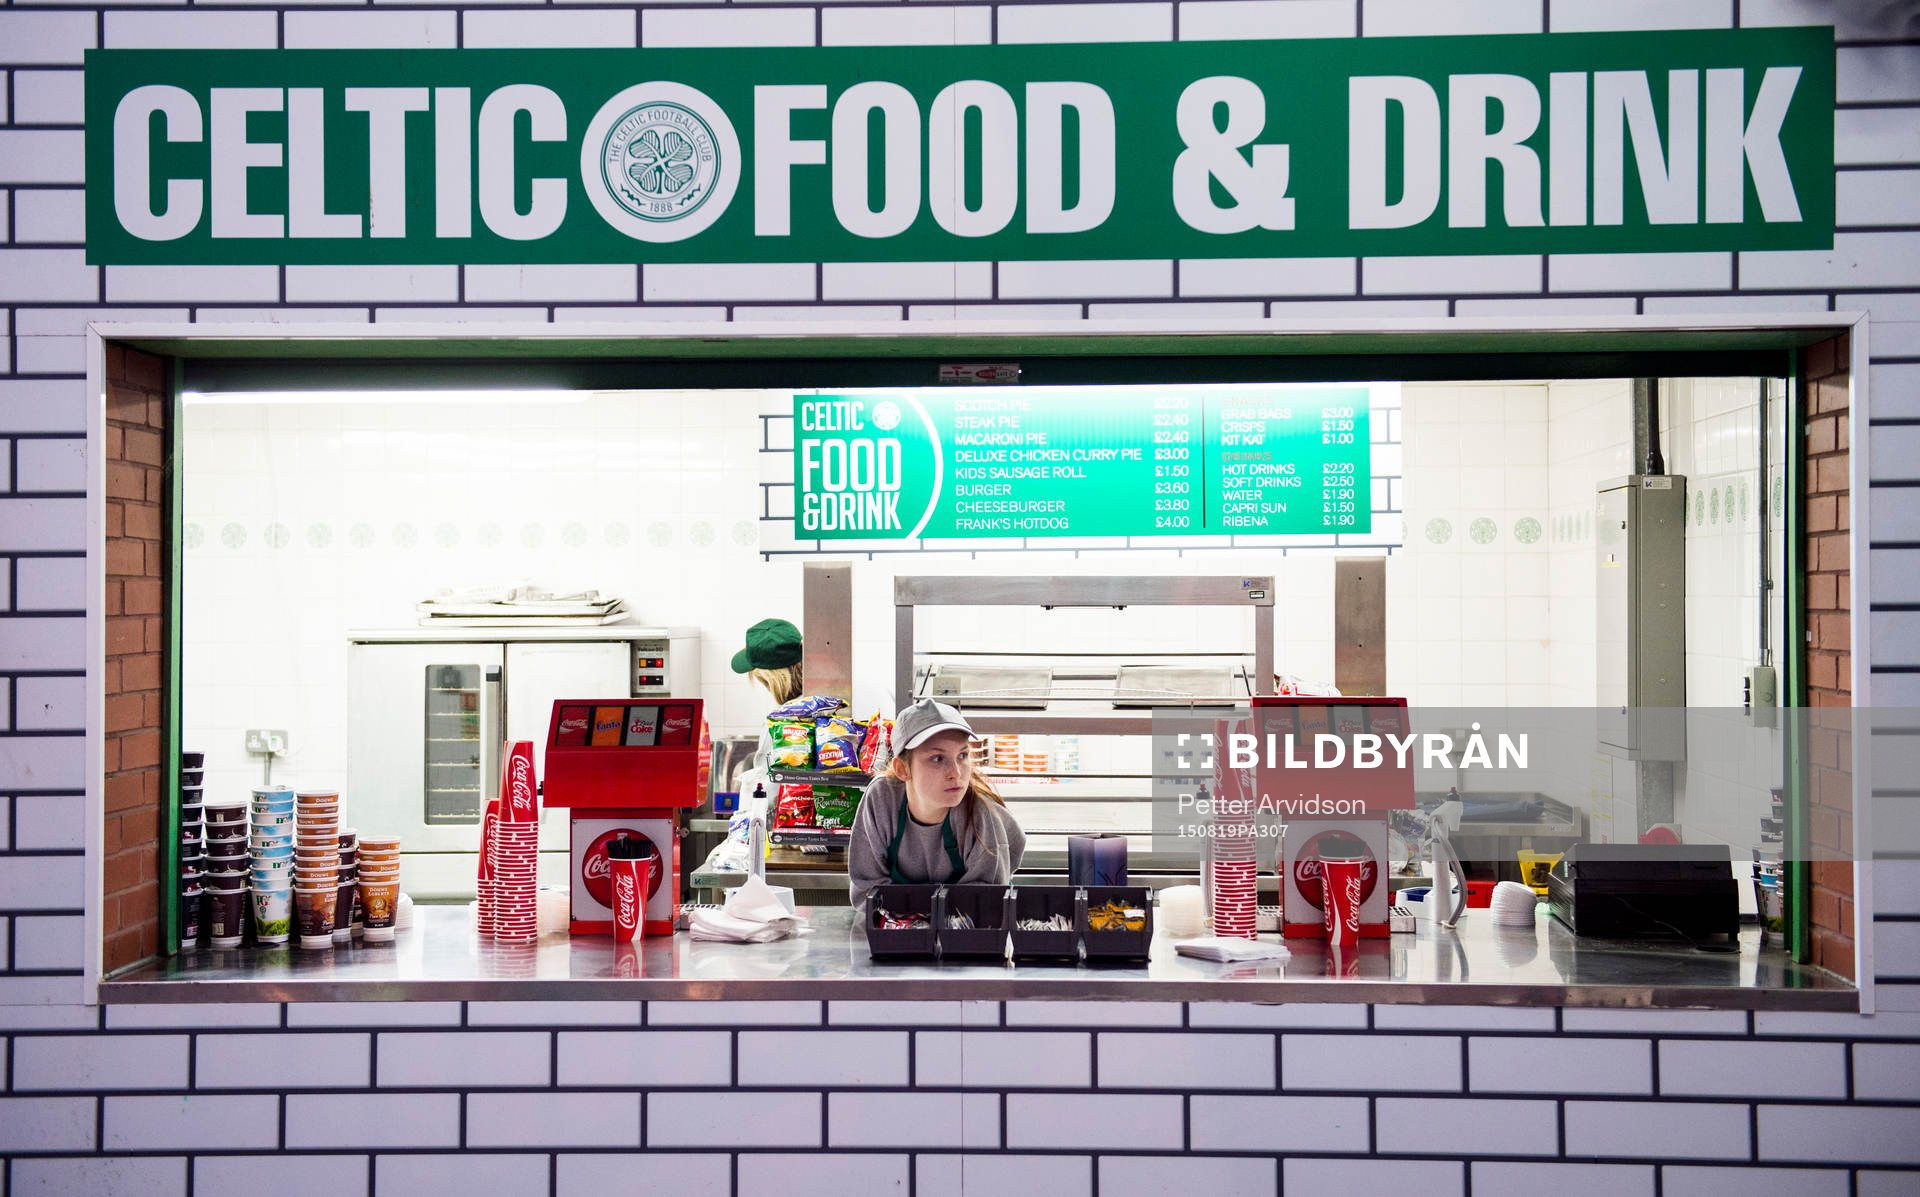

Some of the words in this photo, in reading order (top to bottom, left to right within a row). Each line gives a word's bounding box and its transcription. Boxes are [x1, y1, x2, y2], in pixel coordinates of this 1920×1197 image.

[609, 143, 621, 163] THE
[617, 114, 646, 141] CELTIC
[648, 110, 699, 135] FOOTBALL
[696, 134, 712, 162] CLUB
[114, 84, 567, 241] CELTIC
[754, 80, 1116, 238] FOOD
[1173, 76, 1295, 234] &
[1349, 66, 1803, 229] DRINK
[650, 202, 673, 212] 1888
[802, 401, 864, 431] CELTIC
[1221, 408, 1256, 419] GRAB
[1259, 408, 1292, 419] BAGS
[1321, 408, 1354, 419] £3.00
[955, 416, 996, 429] STEAK
[999, 416, 1020, 428] PIE
[1154, 414, 1189, 426] £2.40
[1221, 421, 1265, 432] CRISPS
[1321, 420, 1353, 431] £1.50
[955, 433, 1023, 446] MACARONI
[1026, 432, 1047, 445] PIE
[1154, 431, 1189, 443] £2.40
[1221, 435, 1240, 446] KIT
[1242, 434, 1265, 445] KAT
[1321, 433, 1354, 444] £1.00
[955, 450, 1007, 463] DELUXE
[1010, 449, 1070, 462] CHICKEN
[1072, 449, 1118, 461] CURRY
[1121, 448, 1142, 460] PIE
[1154, 448, 1189, 460] £3.00
[1222, 451, 1272, 462] DRINKS
[802, 438, 901, 492] FOOD
[1222, 464, 1246, 475] HOT
[1250, 464, 1295, 475] DRINKS
[1322, 463, 1354, 474] £2.20
[955, 467, 986, 480] KIDS
[989, 466, 1050, 479] SAUSAGE
[1052, 466, 1087, 478] ROLL
[1155, 465, 1189, 477] £1.50
[955, 484, 1011, 496] BURGER
[1155, 482, 1189, 494] £3.60
[1222, 477, 1252, 488] SOFT
[1256, 476, 1301, 487] DRINKS
[1322, 476, 1354, 487] £2.50
[1222, 490, 1262, 500] WATER
[1322, 489, 1354, 499] £1.90
[955, 500, 1065, 513] CHEESEBURGER
[1155, 499, 1189, 511] £3.80
[1222, 503, 1258, 514] CAPRI
[1261, 502, 1287, 513] SUN
[1323, 502, 1354, 512] £1.50
[955, 518, 1011, 530] FRANK'S
[1013, 517, 1069, 529] HOTDOG
[1155, 516, 1190, 528] £4.00
[1223, 516, 1268, 526] RIBENA
[1323, 515, 1354, 525] £1.90
